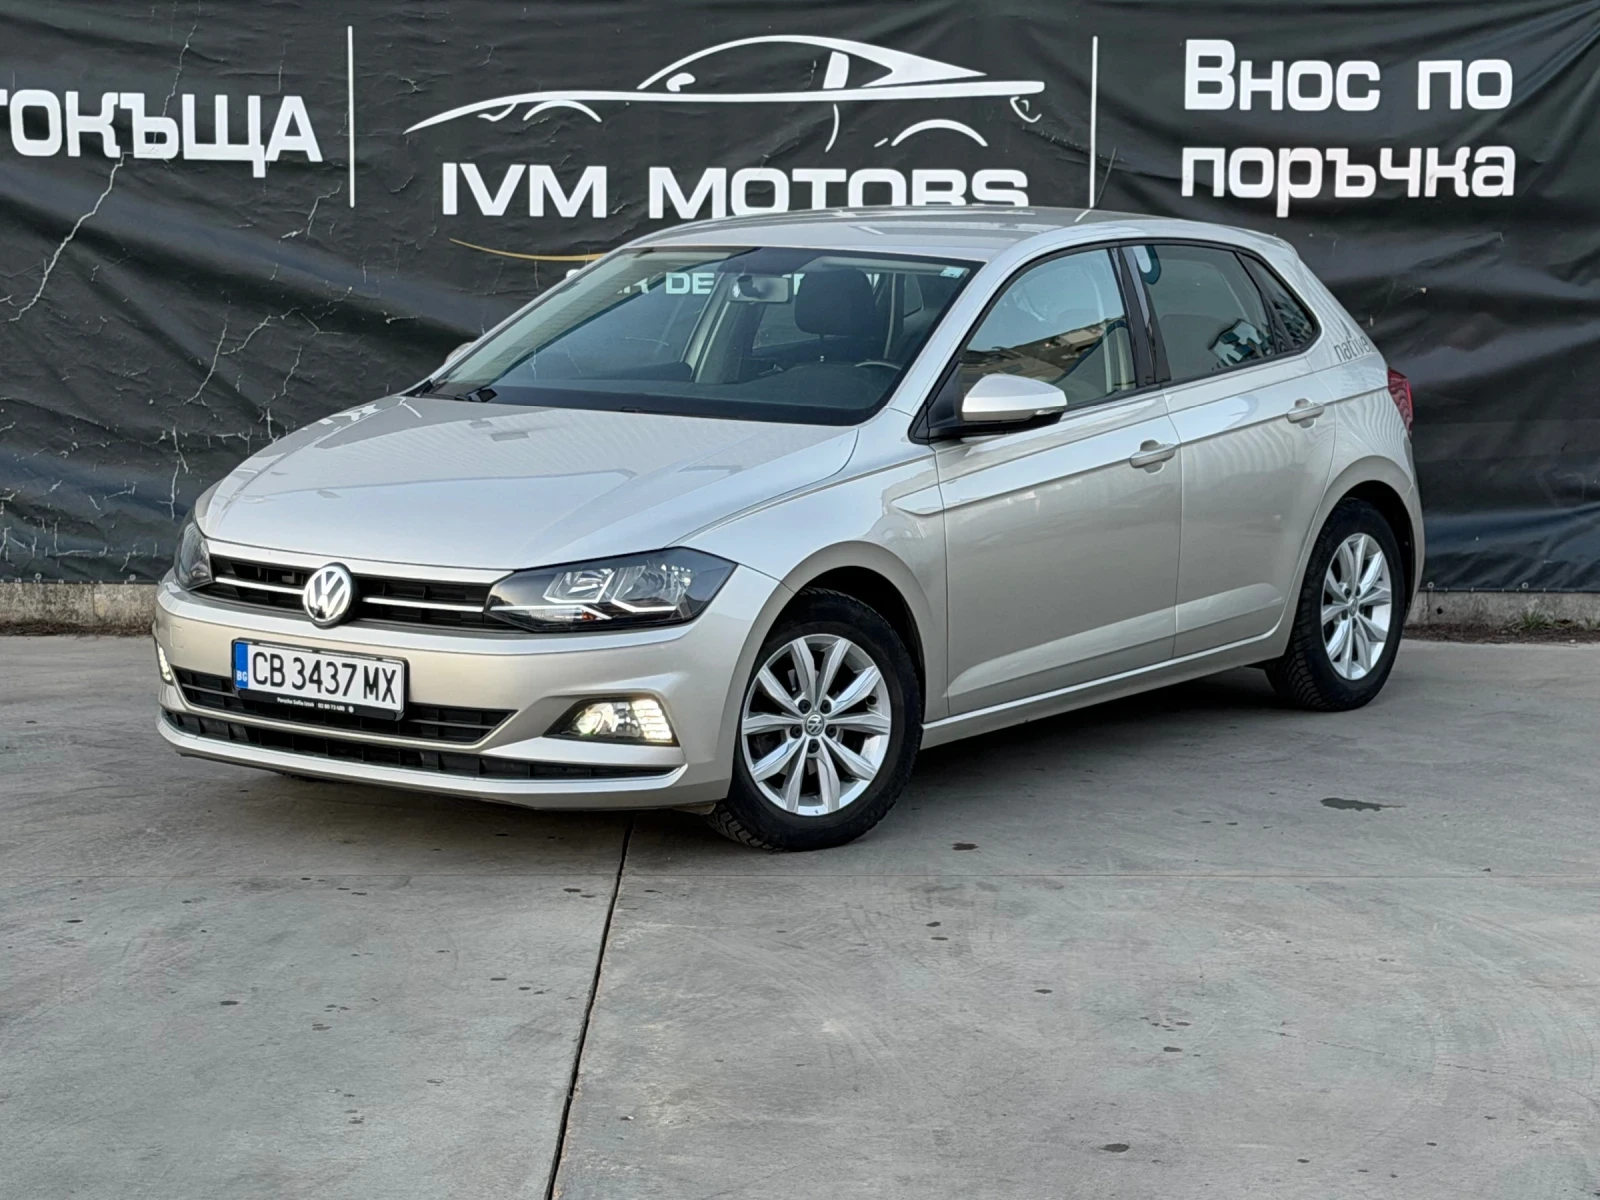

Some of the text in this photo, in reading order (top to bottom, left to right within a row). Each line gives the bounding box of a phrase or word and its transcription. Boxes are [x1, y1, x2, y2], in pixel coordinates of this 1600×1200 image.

[1184, 39, 1513, 111] Внос по
[0, 89, 323, 178] ОКЪЩА
[442, 162, 1029, 219] IVM MOTORS
[1181, 145, 1516, 217] поръчка
[1333, 335, 1372, 362] native
[236, 670, 248, 682] BG
